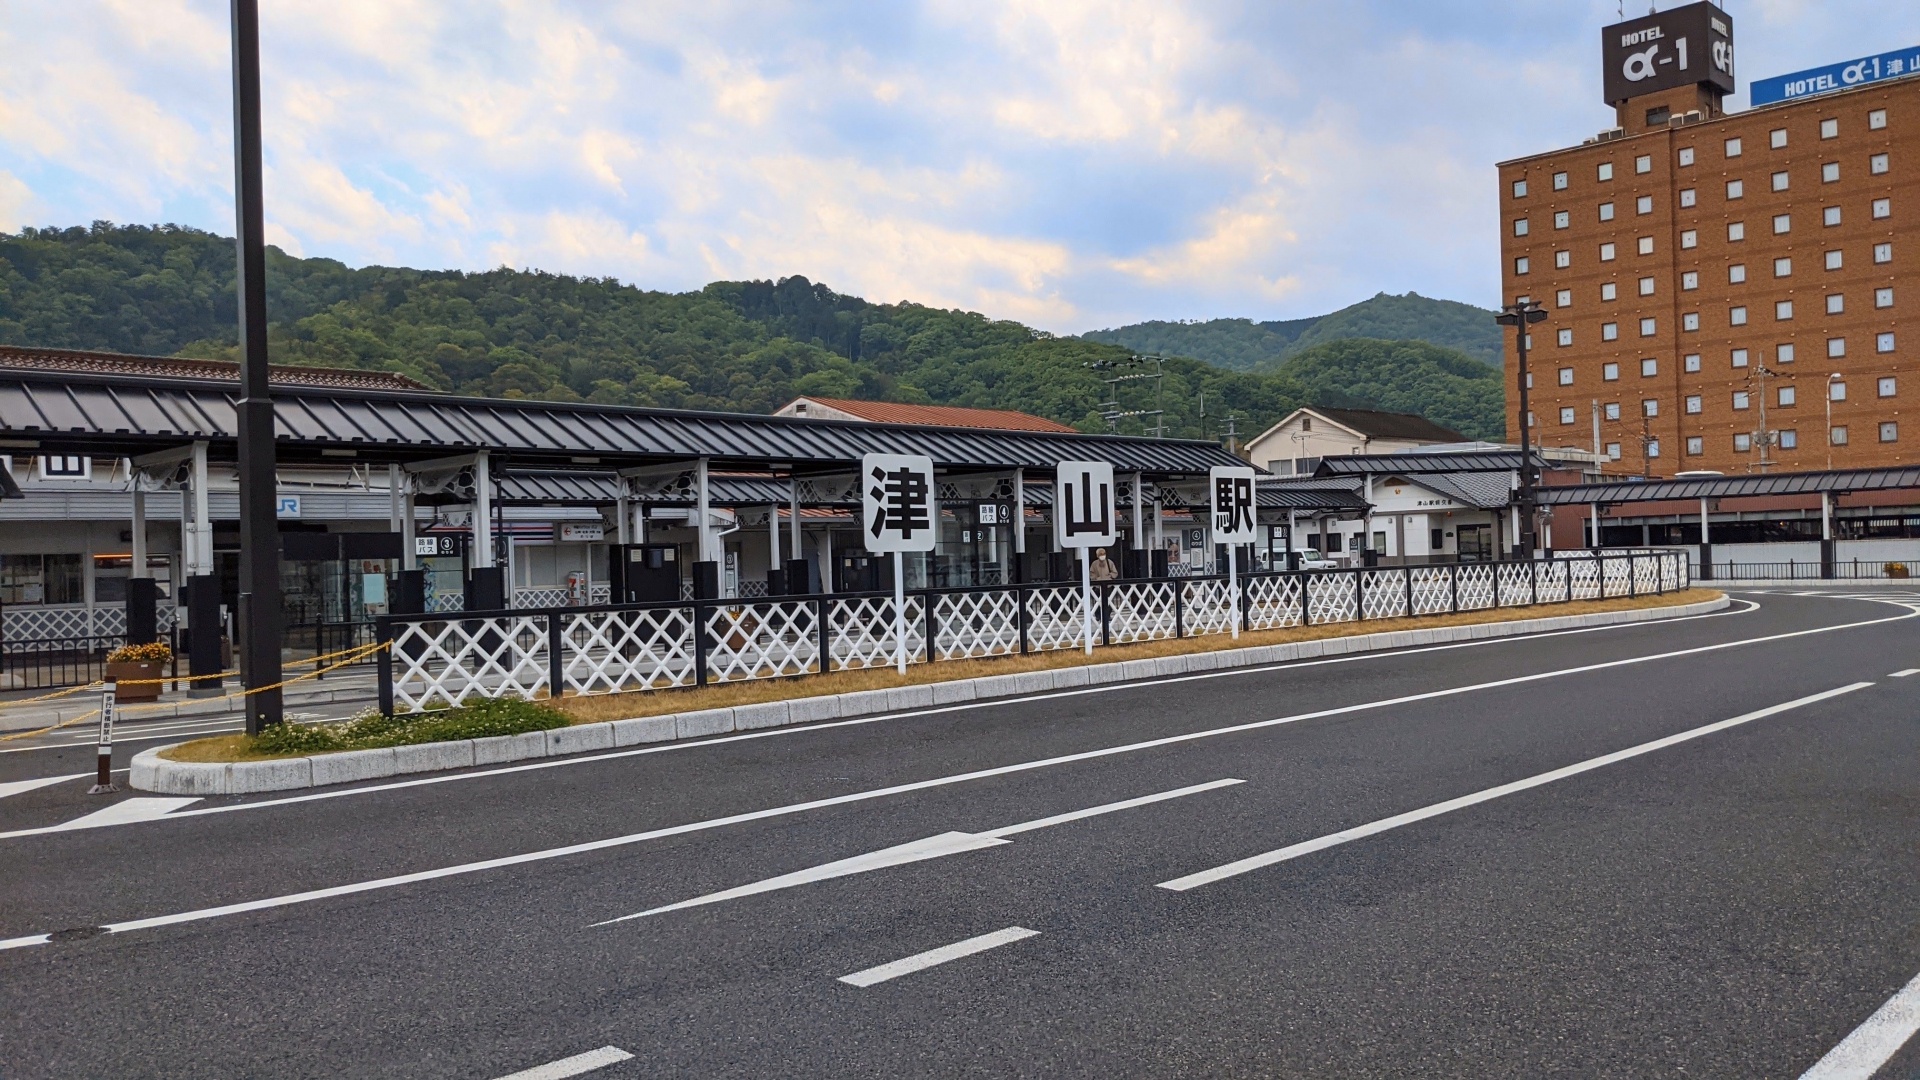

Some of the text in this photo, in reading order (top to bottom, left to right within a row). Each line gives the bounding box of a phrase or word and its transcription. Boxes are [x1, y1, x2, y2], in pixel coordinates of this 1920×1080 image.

[1621, 26, 1664, 48] HOTEL
[1711, 17, 1729, 37] HOTEL
[1784, 74, 1839, 97] HOTEL
[276, 498, 298, 513] JR
[871, 467, 929, 539] 津
[1065, 472, 1109, 537] 山
[1216, 477, 1254, 534] 駅
